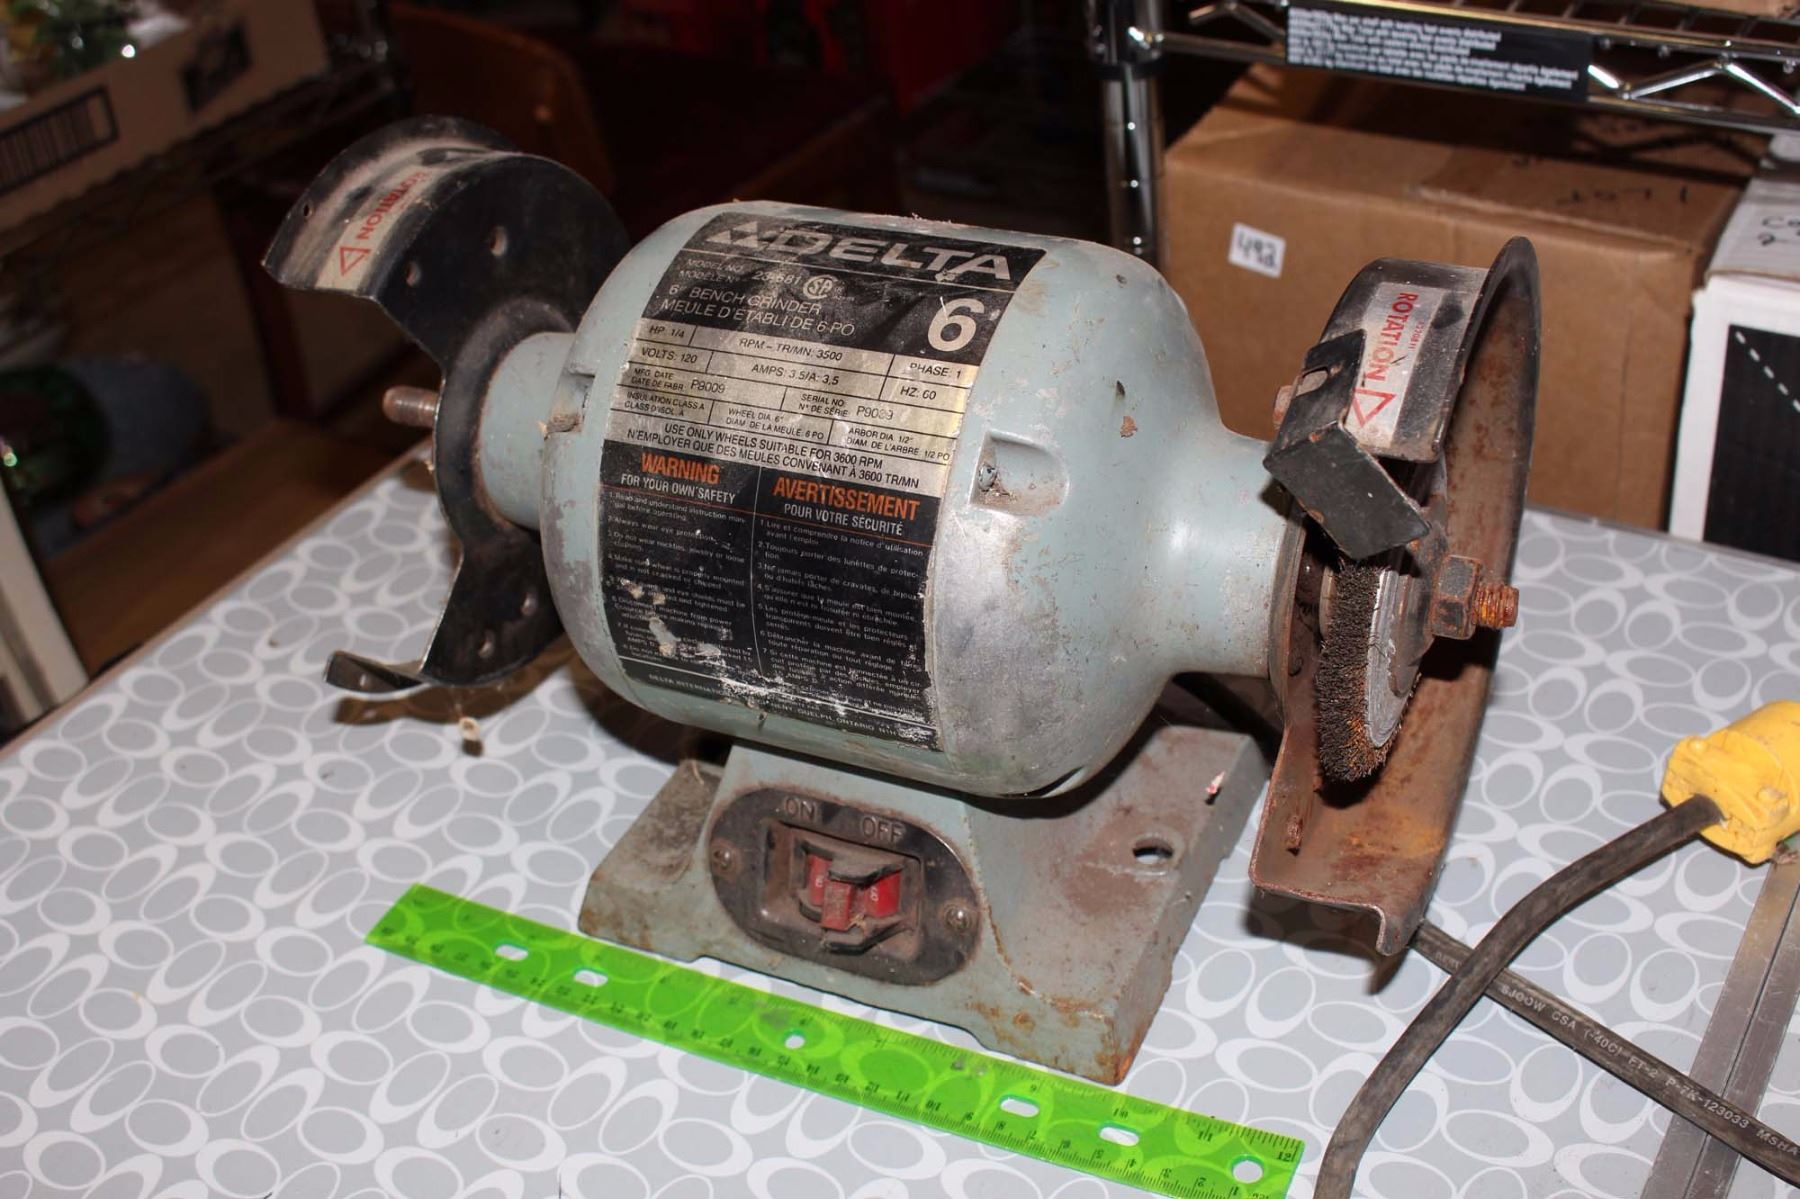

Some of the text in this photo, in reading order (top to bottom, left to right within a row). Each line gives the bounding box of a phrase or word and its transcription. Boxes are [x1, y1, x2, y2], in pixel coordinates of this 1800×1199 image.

[768, 230, 1013, 280] DELTA
[687, 287, 748, 304] BENCH
[744, 295, 825, 315] GRINDER
[657, 298, 719, 317] MEULE
[788, 315, 816, 330] DE
[813, 319, 831, 332] 6
[827, 321, 859, 336] PO
[670, 327, 685, 338] 1/4
[1366, 292, 1420, 382] ROTATION
[640, 346, 698, 364] VOLTS: 120
[738, 337, 765, 350] RPM
[815, 348, 843, 361] 3500
[630, 376, 651, 386] DATE
[651, 379, 663, 387] DE
[653, 370, 674, 379] DATE
[954, 368, 962, 378] 1
[623, 400, 650, 411] CLASS
[676, 409, 685, 417] A
[626, 391, 706, 410] INSULATION CLASS A
[800, 393, 830, 404] SERIAL
[810, 404, 823, 413] DE
[727, 407, 757, 418] WHEEL
[748, 421, 761, 429] DE
[761, 423, 773, 431] LA
[811, 431, 824, 440] PO
[847, 426, 879, 438] ARBOR
[663, 422, 884, 469] USE ONLY WHEELS SUITABLE FOR 3600 RPM
[870, 441, 884, 450] DE
[923, 449, 936, 458] 1/2
[935, 451, 950, 460] PO
[626, 428, 692, 449] N'EMPLOYER
[691, 439, 715, 453] QUE
[714, 443, 738, 457] DES
[737, 447, 782, 465] MEULES
[781, 455, 848, 476] CONVENANT
[857, 468, 884, 482] 3600
[884, 472, 920, 489] TR/MN
[639, 451, 721, 485] WARNING
[619, 472, 736, 505] FOR YOUR OWN SAFETY
[770, 474, 920, 521] AVERTISSEMENT
[783, 502, 903, 536] POUR VOTRE SÉCURITÉ
[783, 796, 906, 843] ON OFF
[1548, 1009, 1578, 1033] CSA
[1625, 1054, 1660, 1080] FT-2
[1754, 1125, 1800, 1159] MSHA
